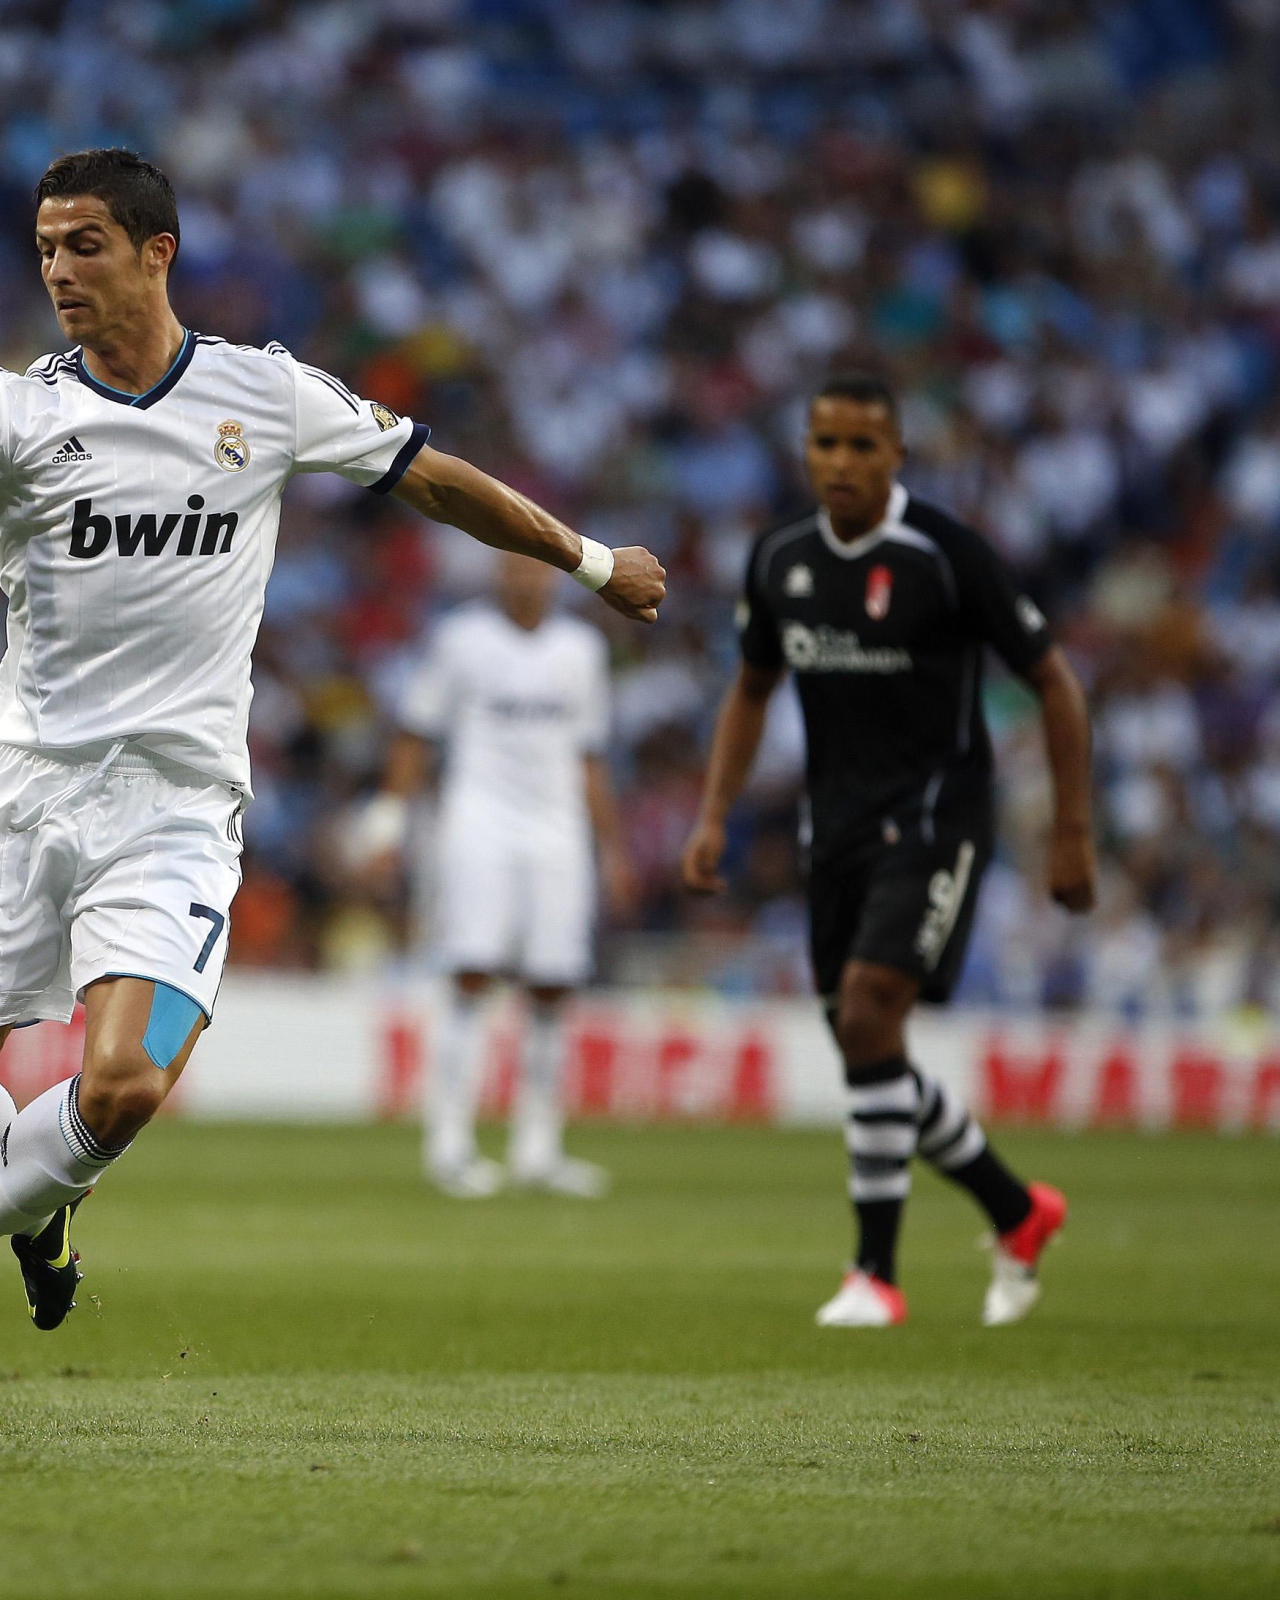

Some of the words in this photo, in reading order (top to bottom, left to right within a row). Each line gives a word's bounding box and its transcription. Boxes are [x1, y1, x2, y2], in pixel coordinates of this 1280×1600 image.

[52, 453, 92, 464] adidas
[68, 494, 239, 559] bwin
[189, 902, 225, 974] 7
